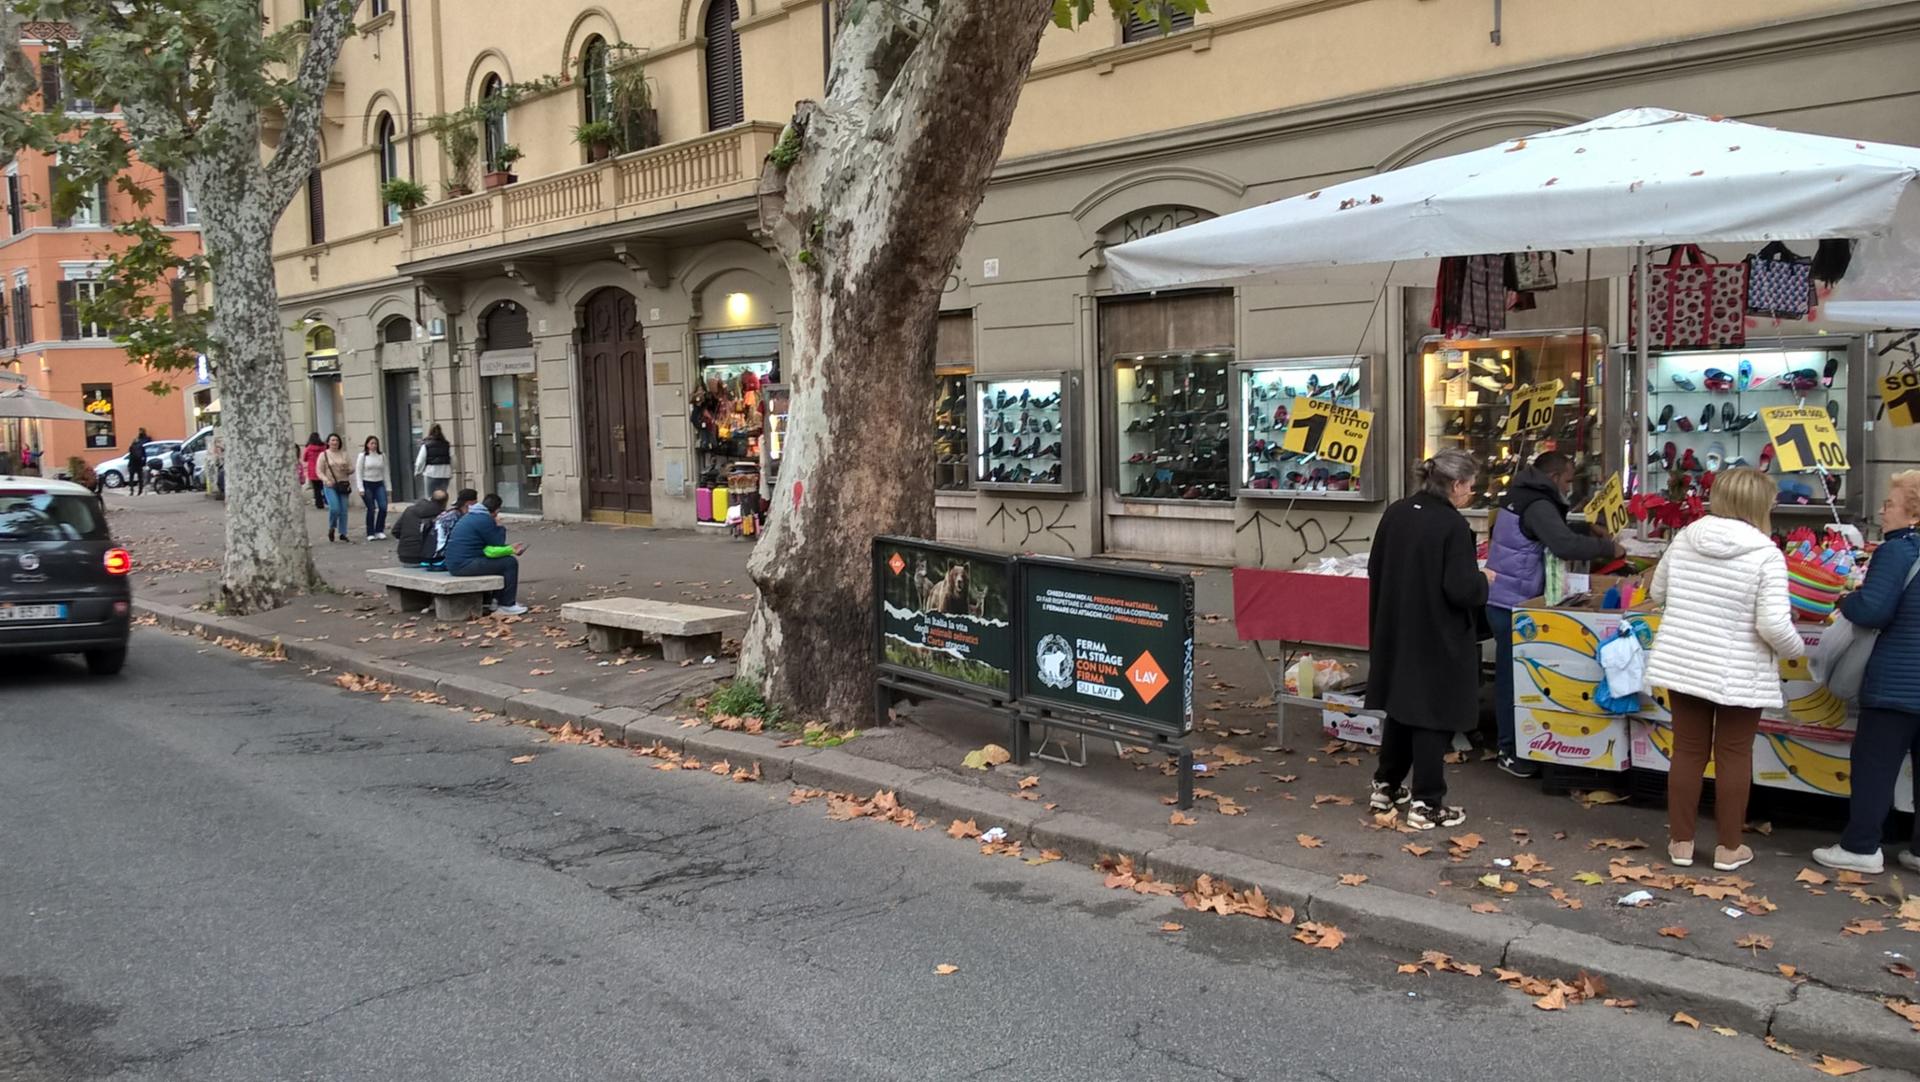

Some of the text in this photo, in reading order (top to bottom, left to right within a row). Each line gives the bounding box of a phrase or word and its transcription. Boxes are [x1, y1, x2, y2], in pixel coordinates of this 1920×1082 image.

[1309, 400, 1358, 418] OFFERTA
[1333, 414, 1369, 430] TUTTO
[913, 623, 929, 635] degli
[932, 617, 948, 628] Italia
[948, 620, 955, 630] la
[956, 622, 968, 633] vita
[1076, 638, 1107, 653] FERMA
[1076, 649, 1123, 666] LA STRAGE
[1076, 660, 1118, 676] CON UNA
[1076, 670, 1105, 684] FIRMA
[1135, 669, 1158, 685] LAV
[1078, 682, 1118, 698] SU LAV.IT
